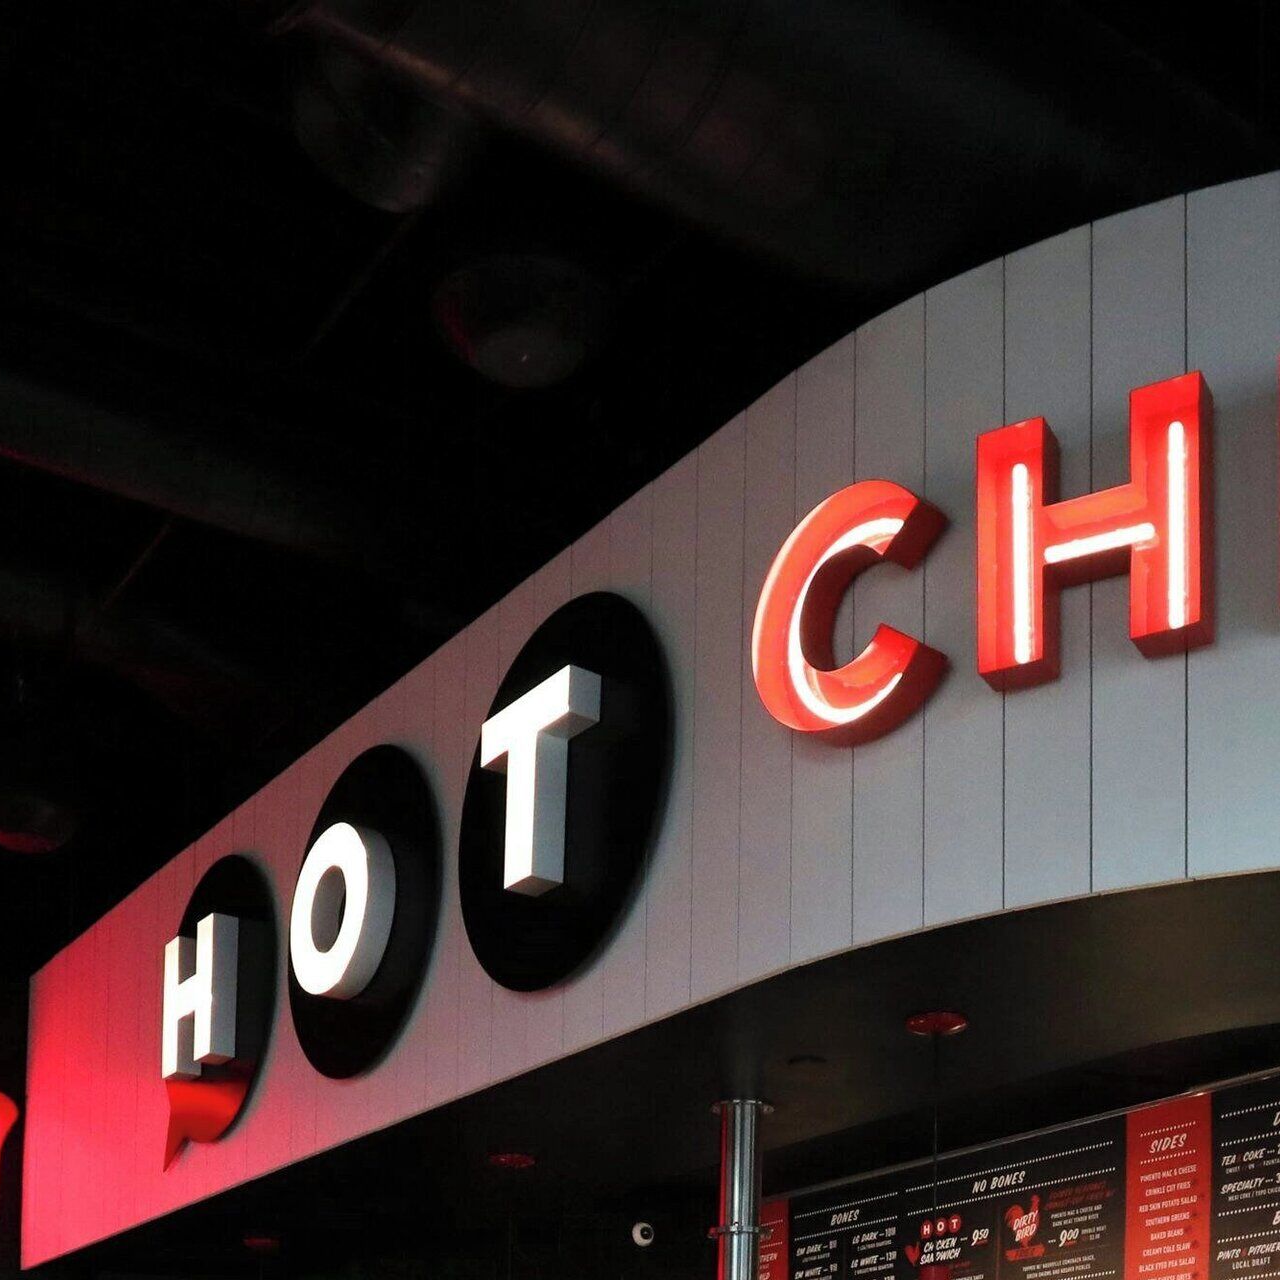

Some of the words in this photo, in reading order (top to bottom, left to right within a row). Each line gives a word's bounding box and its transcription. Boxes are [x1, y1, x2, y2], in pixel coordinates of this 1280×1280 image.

[162, 664, 601, 1080] HOT
[1149, 1133, 1187, 1154] SIDES
[1221, 1155, 1236, 1166] TEA
[1243, 1148, 1266, 1162] COKE
[1178, 1164, 1197, 1174] CHEESE
[972, 1179, 987, 1193] NO
[991, 1171, 1026, 1190] BONES
[1220, 1177, 1264, 1194] SPECIALTY
[830, 1209, 860, 1226] BONES
[1013, 1210, 1038, 1231] DIRTY
[923, 1219, 958, 1235] HOT
[1015, 1223, 1037, 1242] BIRD
[923, 1237, 957, 1253] CHCKEN
[1217, 1248, 1241, 1261] PINTS
